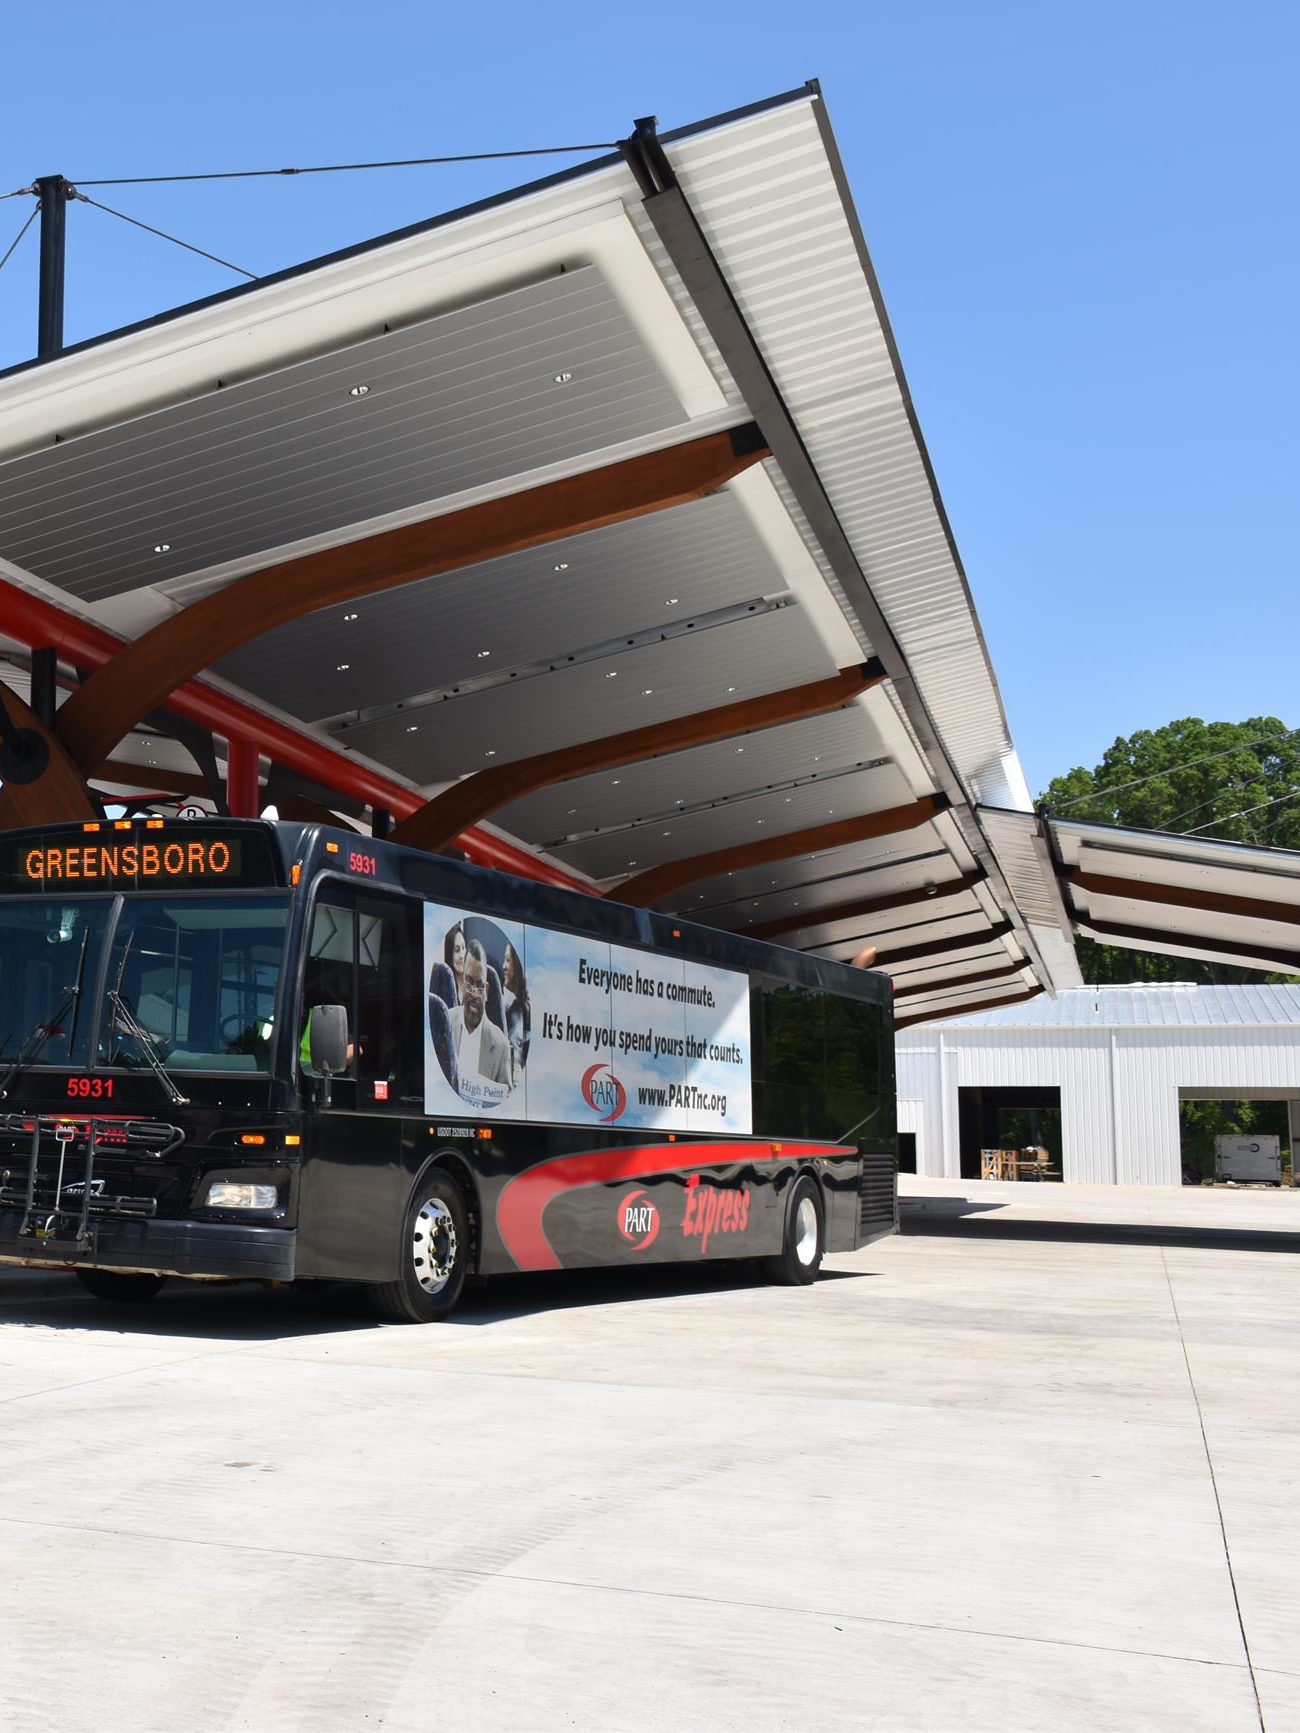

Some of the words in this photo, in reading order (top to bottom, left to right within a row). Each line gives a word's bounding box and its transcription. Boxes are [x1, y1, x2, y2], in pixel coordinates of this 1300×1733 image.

[25, 842, 230, 878] GREENSBORO
[349, 852, 376, 875] 5931
[578, 958, 633, 994] Everyone
[635, 969, 655, 997] has
[657, 981, 664, 998] a
[666, 982, 715, 1008] commute.
[542, 1012, 563, 1041] It's
[566, 1015, 592, 1044] how
[594, 1026, 616, 1051] you
[619, 1028, 652, 1055] spend
[654, 1036, 684, 1059] yours
[686, 1035, 707, 1060] that
[709, 1042, 743, 1065] counts.
[67, 1078, 113, 1098] 5931
[461, 1079, 482, 1097] High
[483, 1086, 504, 1099] Point
[590, 1079, 620, 1106] PART
[638, 1083, 727, 1117] www.PARTnc.org
[437, 1126, 451, 1137] USDOT
[624, 1207, 655, 1233] PART
[680, 1173, 750, 1255] Express
